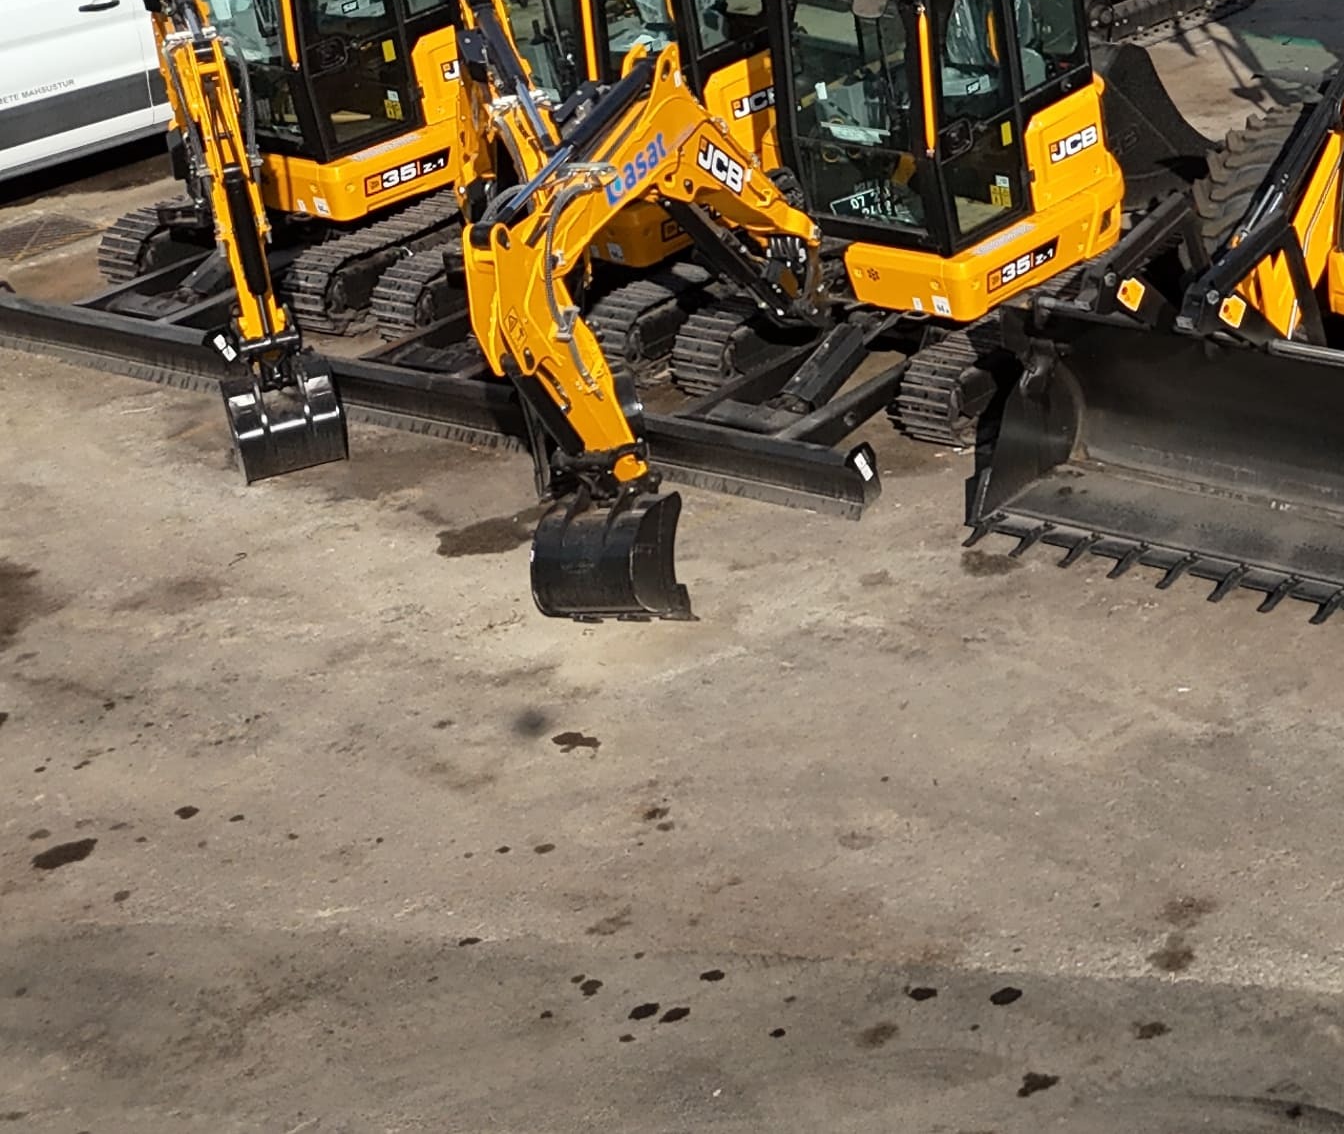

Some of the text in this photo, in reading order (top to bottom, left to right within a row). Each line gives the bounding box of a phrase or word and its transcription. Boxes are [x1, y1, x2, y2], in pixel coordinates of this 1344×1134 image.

[623, 132, 667, 188] asat
[1050, 125, 1098, 163] JCB
[382, 163, 417, 188] 35
[698, 142, 745, 194] JCB
[1001, 254, 1031, 283] 35
